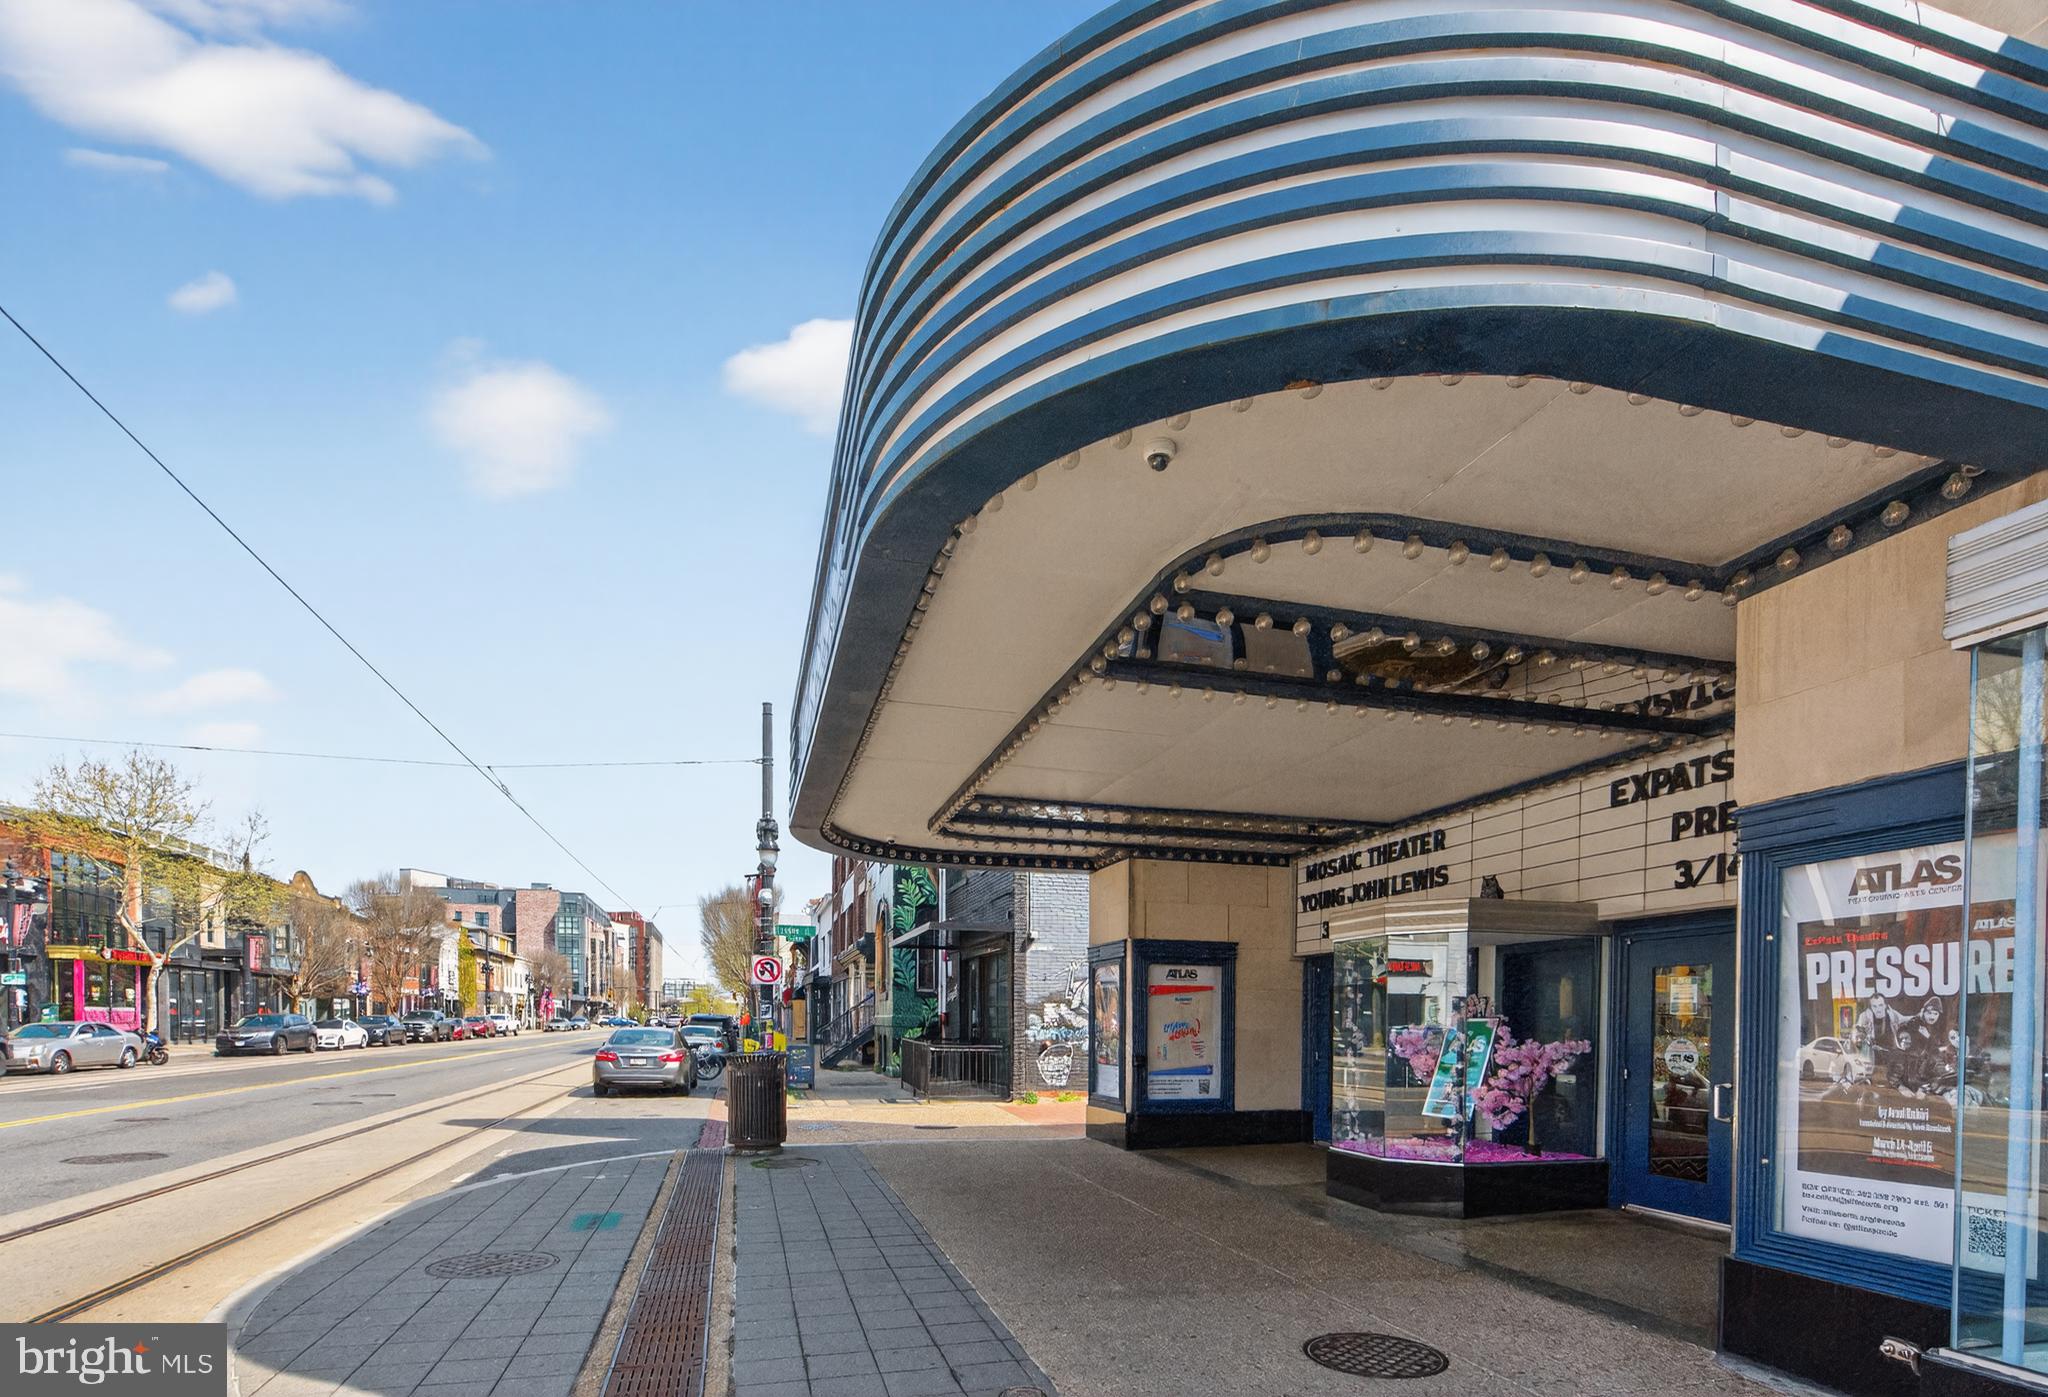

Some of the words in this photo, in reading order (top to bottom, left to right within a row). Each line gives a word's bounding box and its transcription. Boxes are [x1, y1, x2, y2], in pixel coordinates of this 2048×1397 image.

[1610, 750, 1735, 807] EXPATS
[1306, 851, 1362, 882] MOSAIC
[1367, 829, 1446, 867] THEATER
[1848, 854, 1963, 896] ATLAS
[1300, 887, 1346, 912] YOUNG
[1347, 878, 1389, 903] JOHN
[1391, 865, 1449, 895] LEWIS
[1165, 968, 1198, 979] ATLAS
[1805, 937, 2015, 1000] PRESSURE
